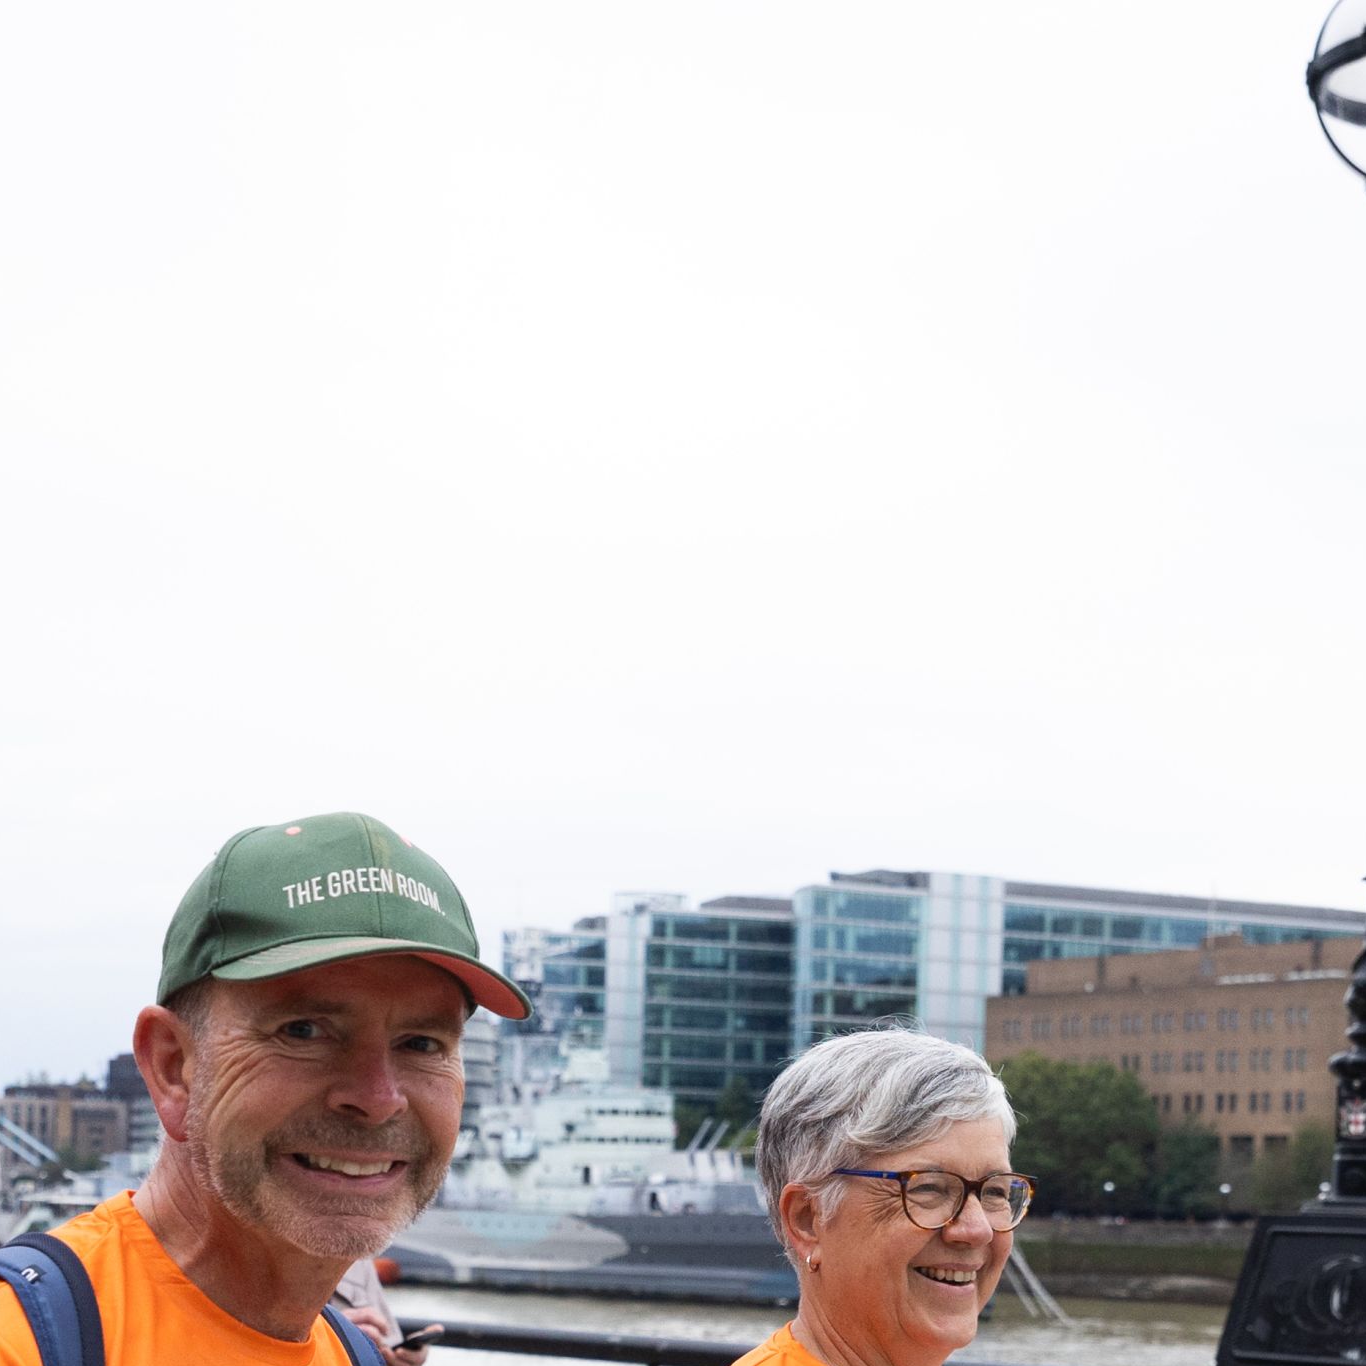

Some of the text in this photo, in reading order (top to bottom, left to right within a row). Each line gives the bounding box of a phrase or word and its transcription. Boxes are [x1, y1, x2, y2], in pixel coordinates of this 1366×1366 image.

[282, 867, 446, 916] THE GREEN ROOM.
